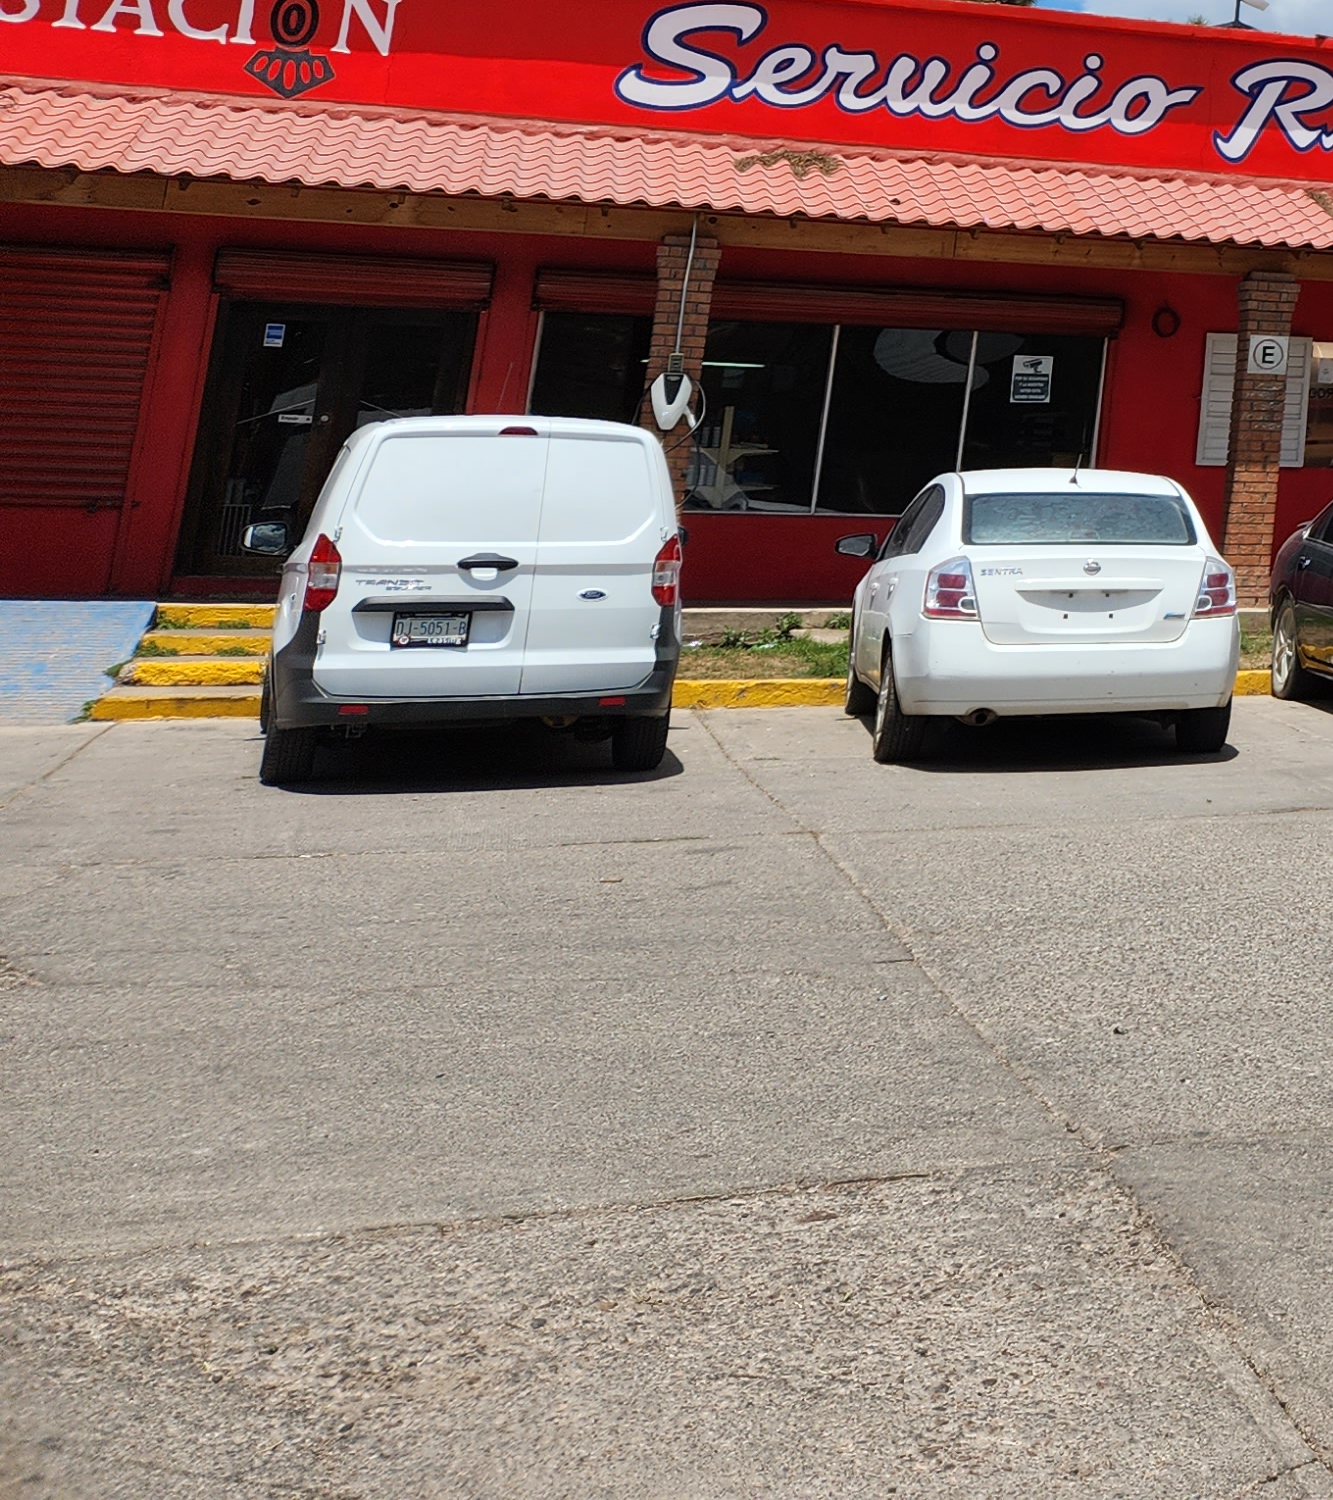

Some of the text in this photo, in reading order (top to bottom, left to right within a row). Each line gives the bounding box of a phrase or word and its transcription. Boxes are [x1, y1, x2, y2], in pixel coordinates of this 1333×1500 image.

[615, 0, 1203, 135] Servicio
[1262, 346, 1275, 364] E
[980, 568, 1023, 576] SENTRA
[396, 621, 466, 637] DJ-5051-B
